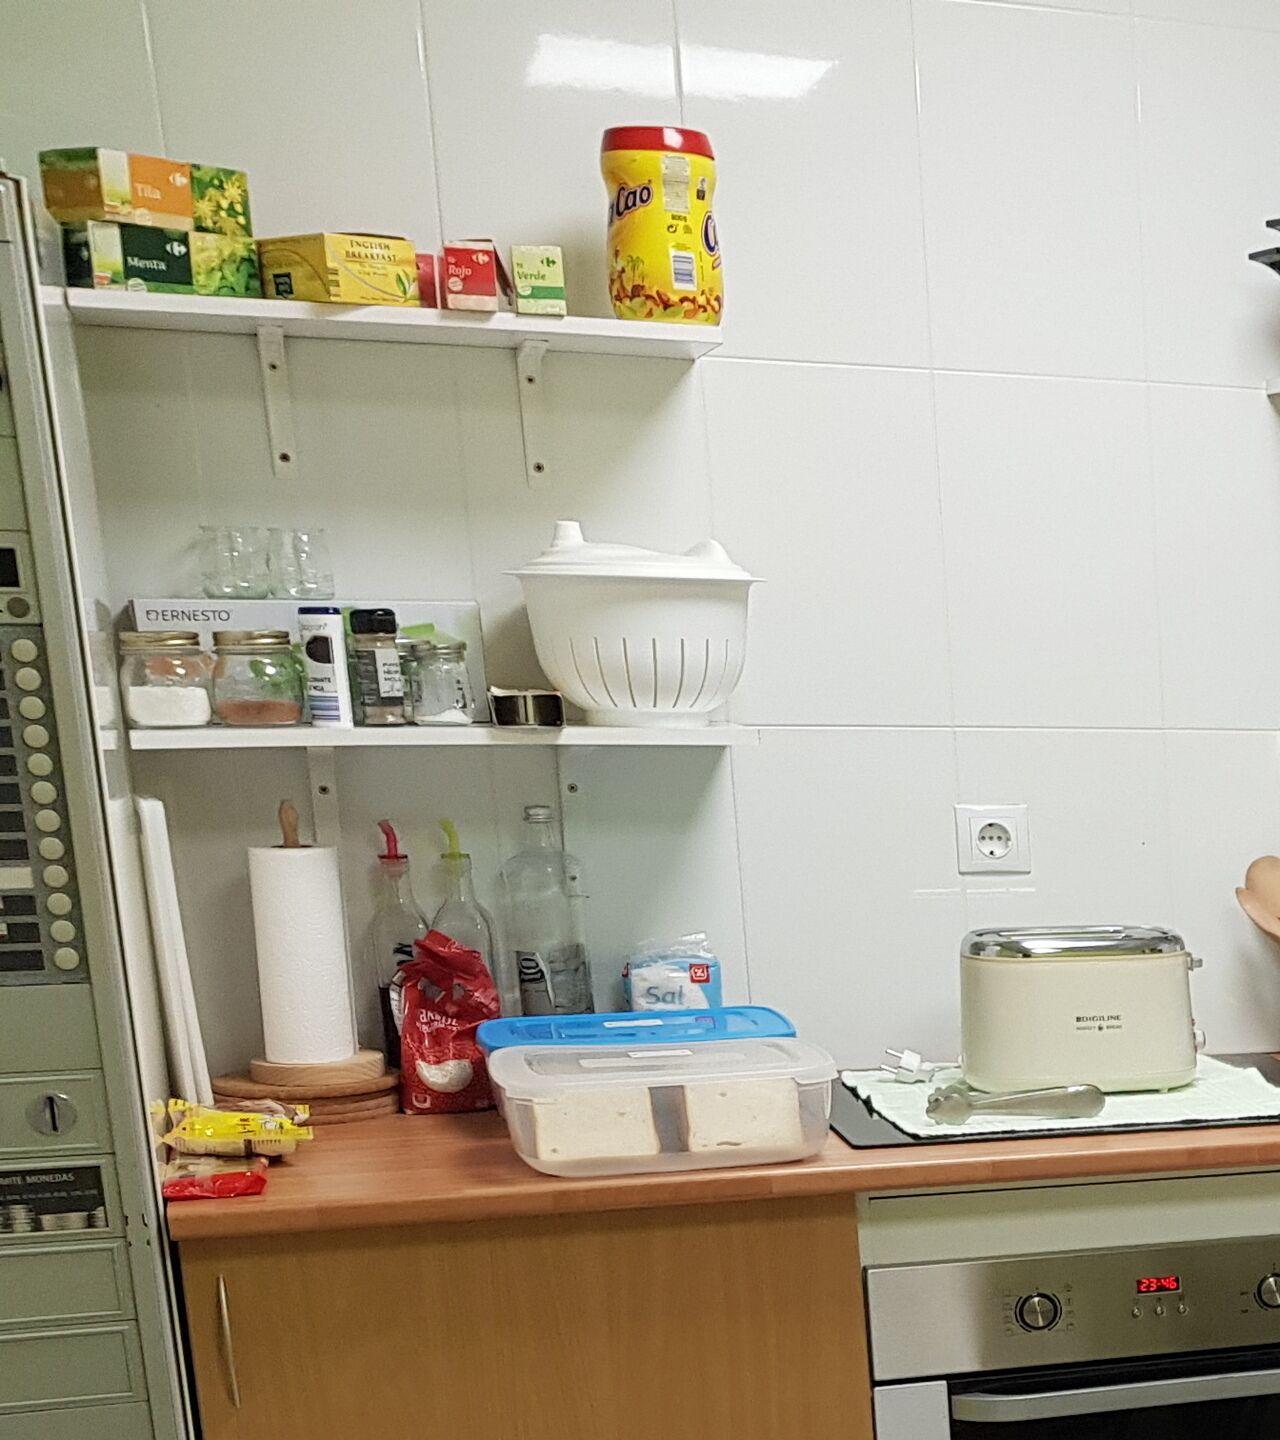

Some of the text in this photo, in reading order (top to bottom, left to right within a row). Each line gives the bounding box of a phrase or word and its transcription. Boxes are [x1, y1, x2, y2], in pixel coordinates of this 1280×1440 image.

[615, 185, 652, 218] Cao
[350, 239, 390, 252] ENGLISH
[345, 250, 398, 263] BREAKFAST
[127, 256, 167, 272] Menta
[448, 264, 472, 277] Rojo
[517, 270, 547, 281] Verde
[162, 608, 230, 623] ERNESTO
[645, 984, 684, 1005] Sal
[26, 1172, 75, 1184] MONEDAS
